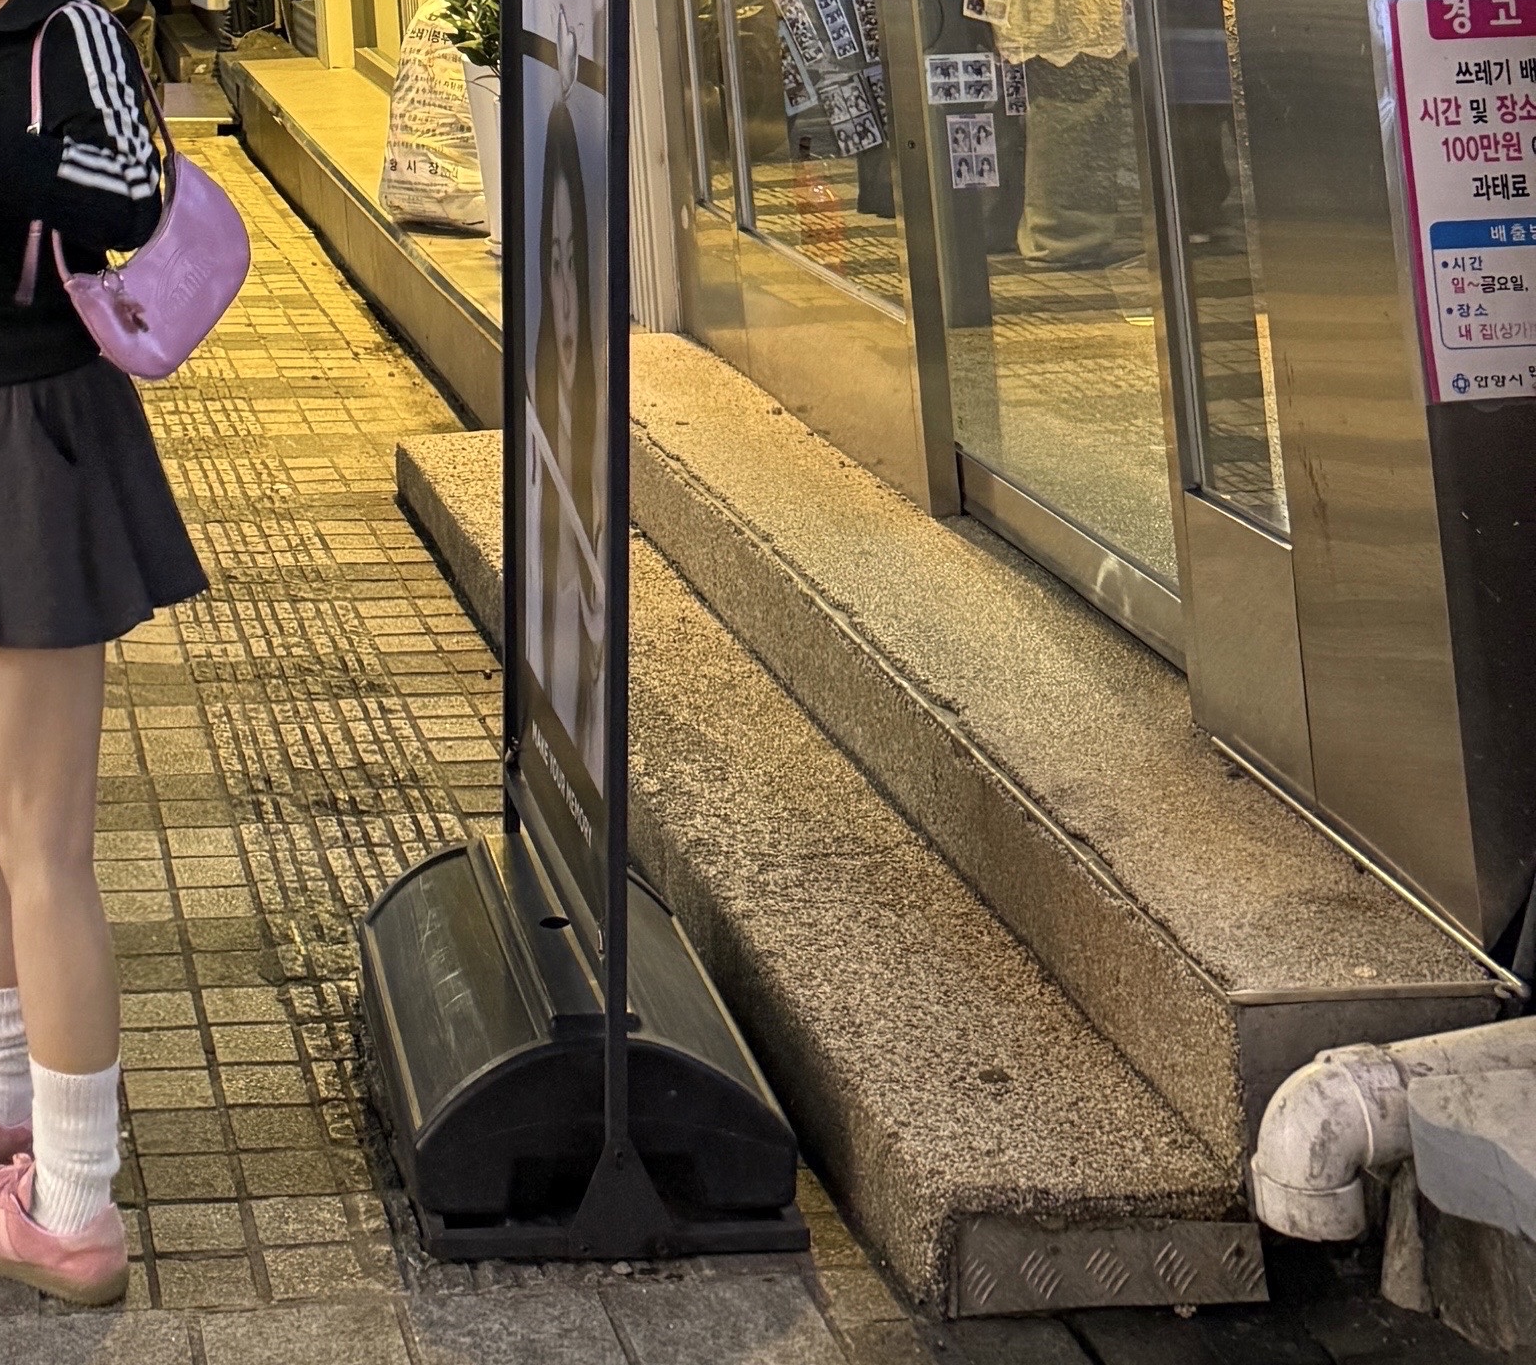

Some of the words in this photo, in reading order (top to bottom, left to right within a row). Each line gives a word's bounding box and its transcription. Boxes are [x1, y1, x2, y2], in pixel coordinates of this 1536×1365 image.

[1455, 58, 1512, 86] 쓰레기
[1420, 96, 1462, 127] 시간
[1469, 97, 1489, 125] 및
[1496, 93, 1536, 125] 장소
[1441, 131, 1524, 163] 100만원
[1472, 173, 1531, 201] 과태료
[1451, 255, 1484, 272] 시간
[1456, 303, 1490, 319] 장소
[1458, 323, 1473, 342] 내
[1473, 373, 1524, 390] 안양시
